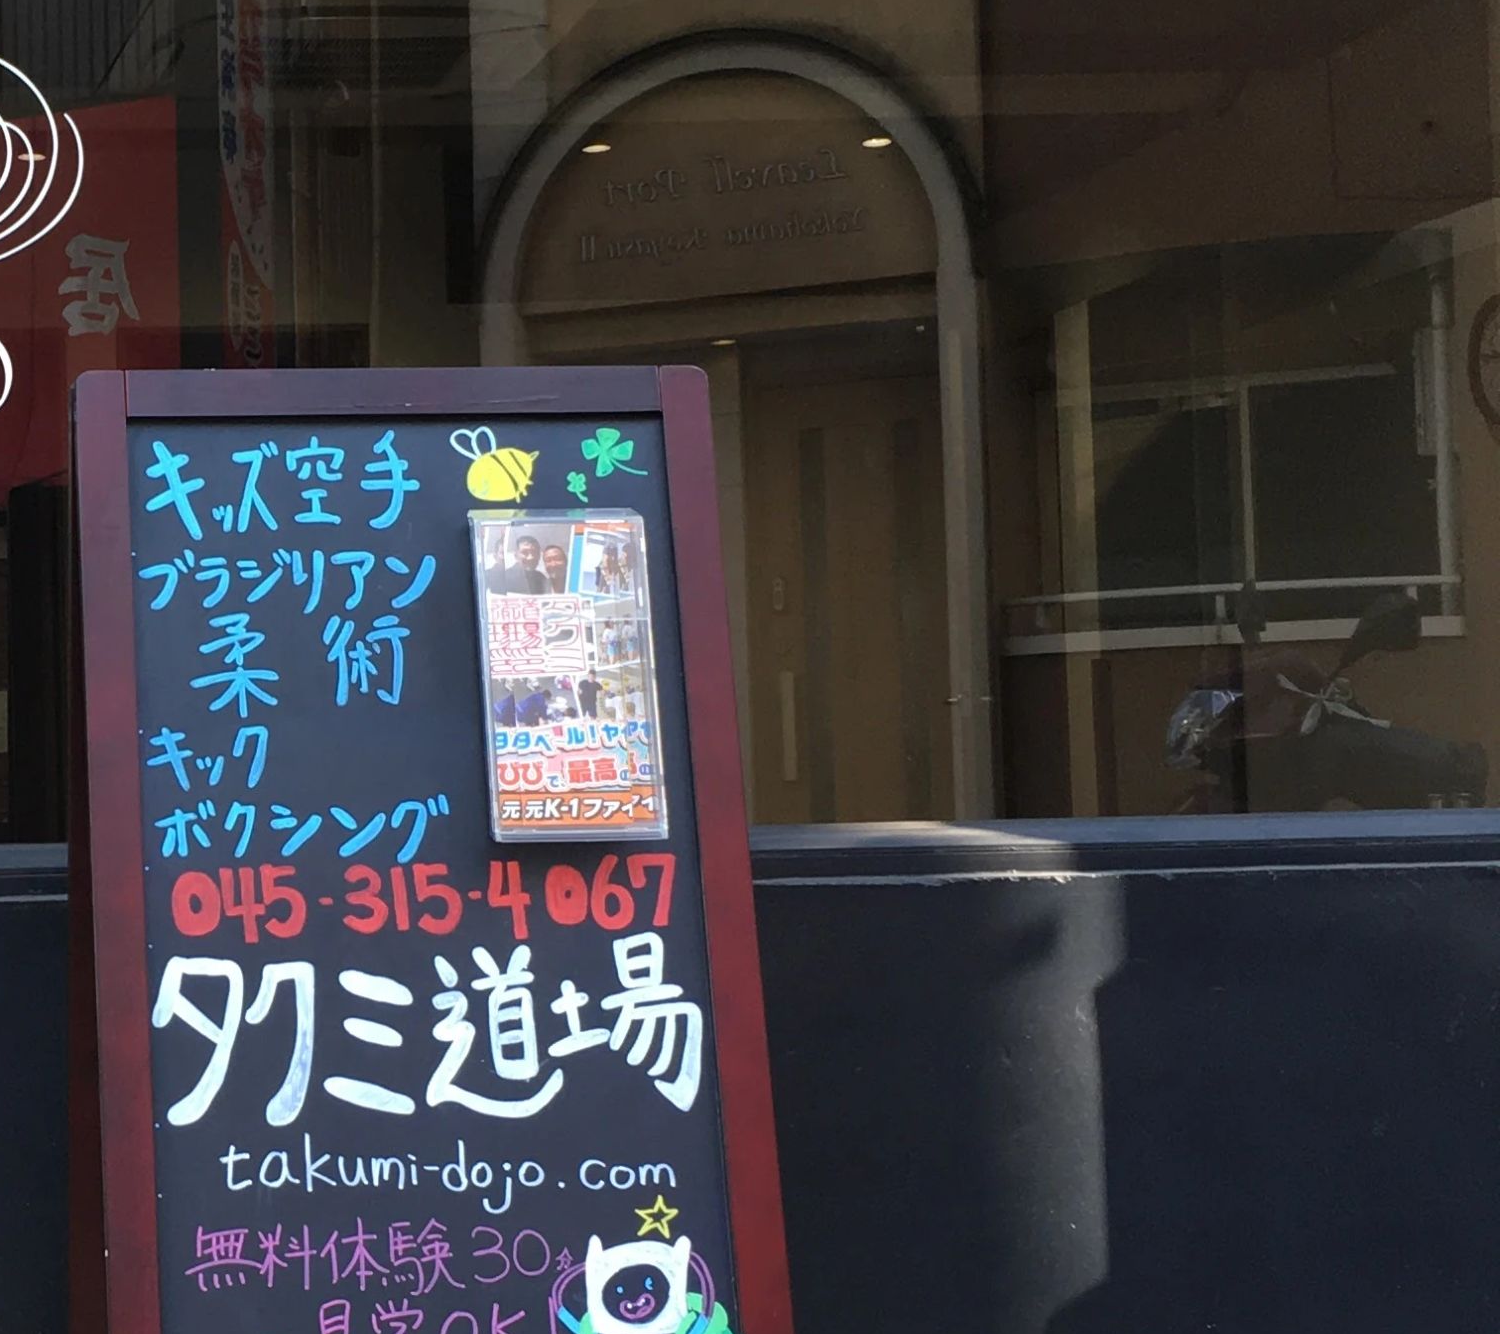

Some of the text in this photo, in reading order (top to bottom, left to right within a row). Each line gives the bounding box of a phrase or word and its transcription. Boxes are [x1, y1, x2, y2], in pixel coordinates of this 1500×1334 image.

[145, 428, 421, 541] キッズ空手
[137, 548, 437, 614] ブラジリアン
[146, 724, 269, 792] キック
[153, 793, 450, 863] ボクシング
[151, 931, 703, 1127] タクミ道場
